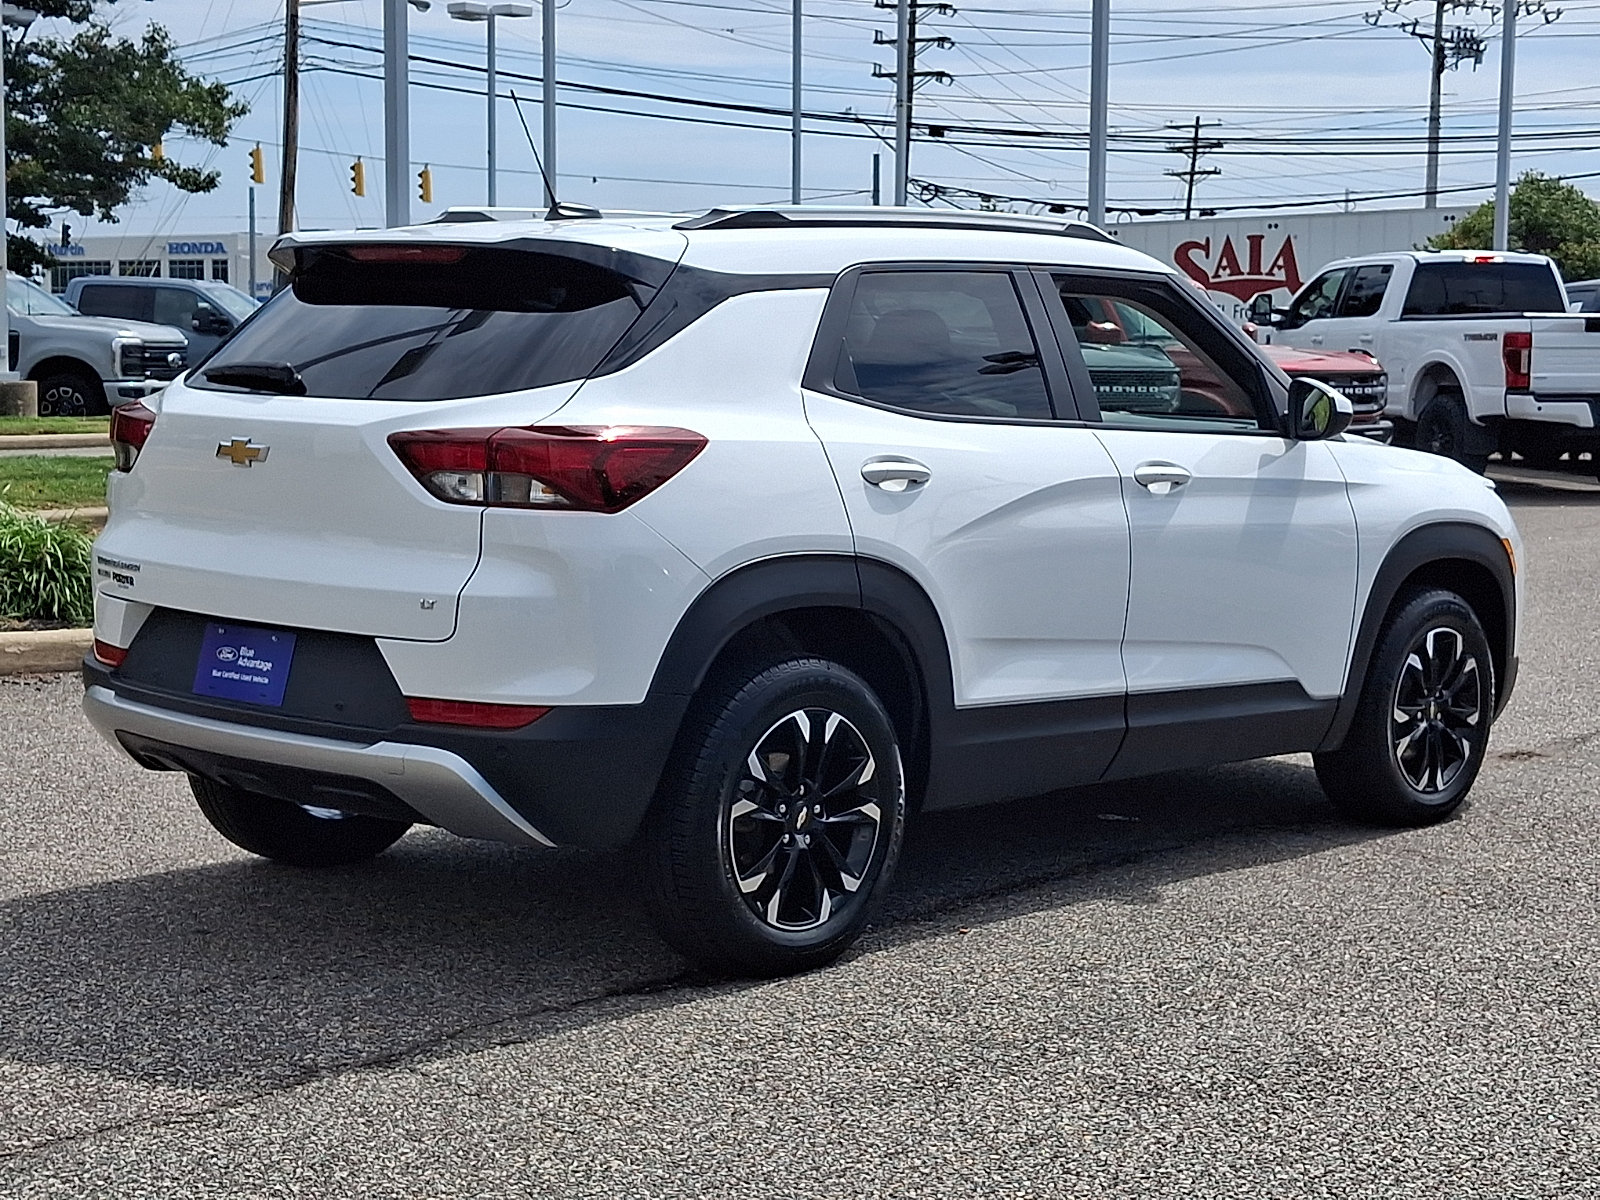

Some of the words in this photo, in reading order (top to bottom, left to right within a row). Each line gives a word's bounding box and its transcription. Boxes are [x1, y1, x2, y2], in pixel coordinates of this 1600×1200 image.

[168, 242, 227, 254] HONDA
[1173, 233, 1305, 298] SAIA
[240, 646, 255, 657] Blue
[237, 657, 273, 672] Advantage
[212, 669, 221, 677] Blue
[221, 671, 240, 680] Certified
[252, 675, 269, 684] Vehicle
